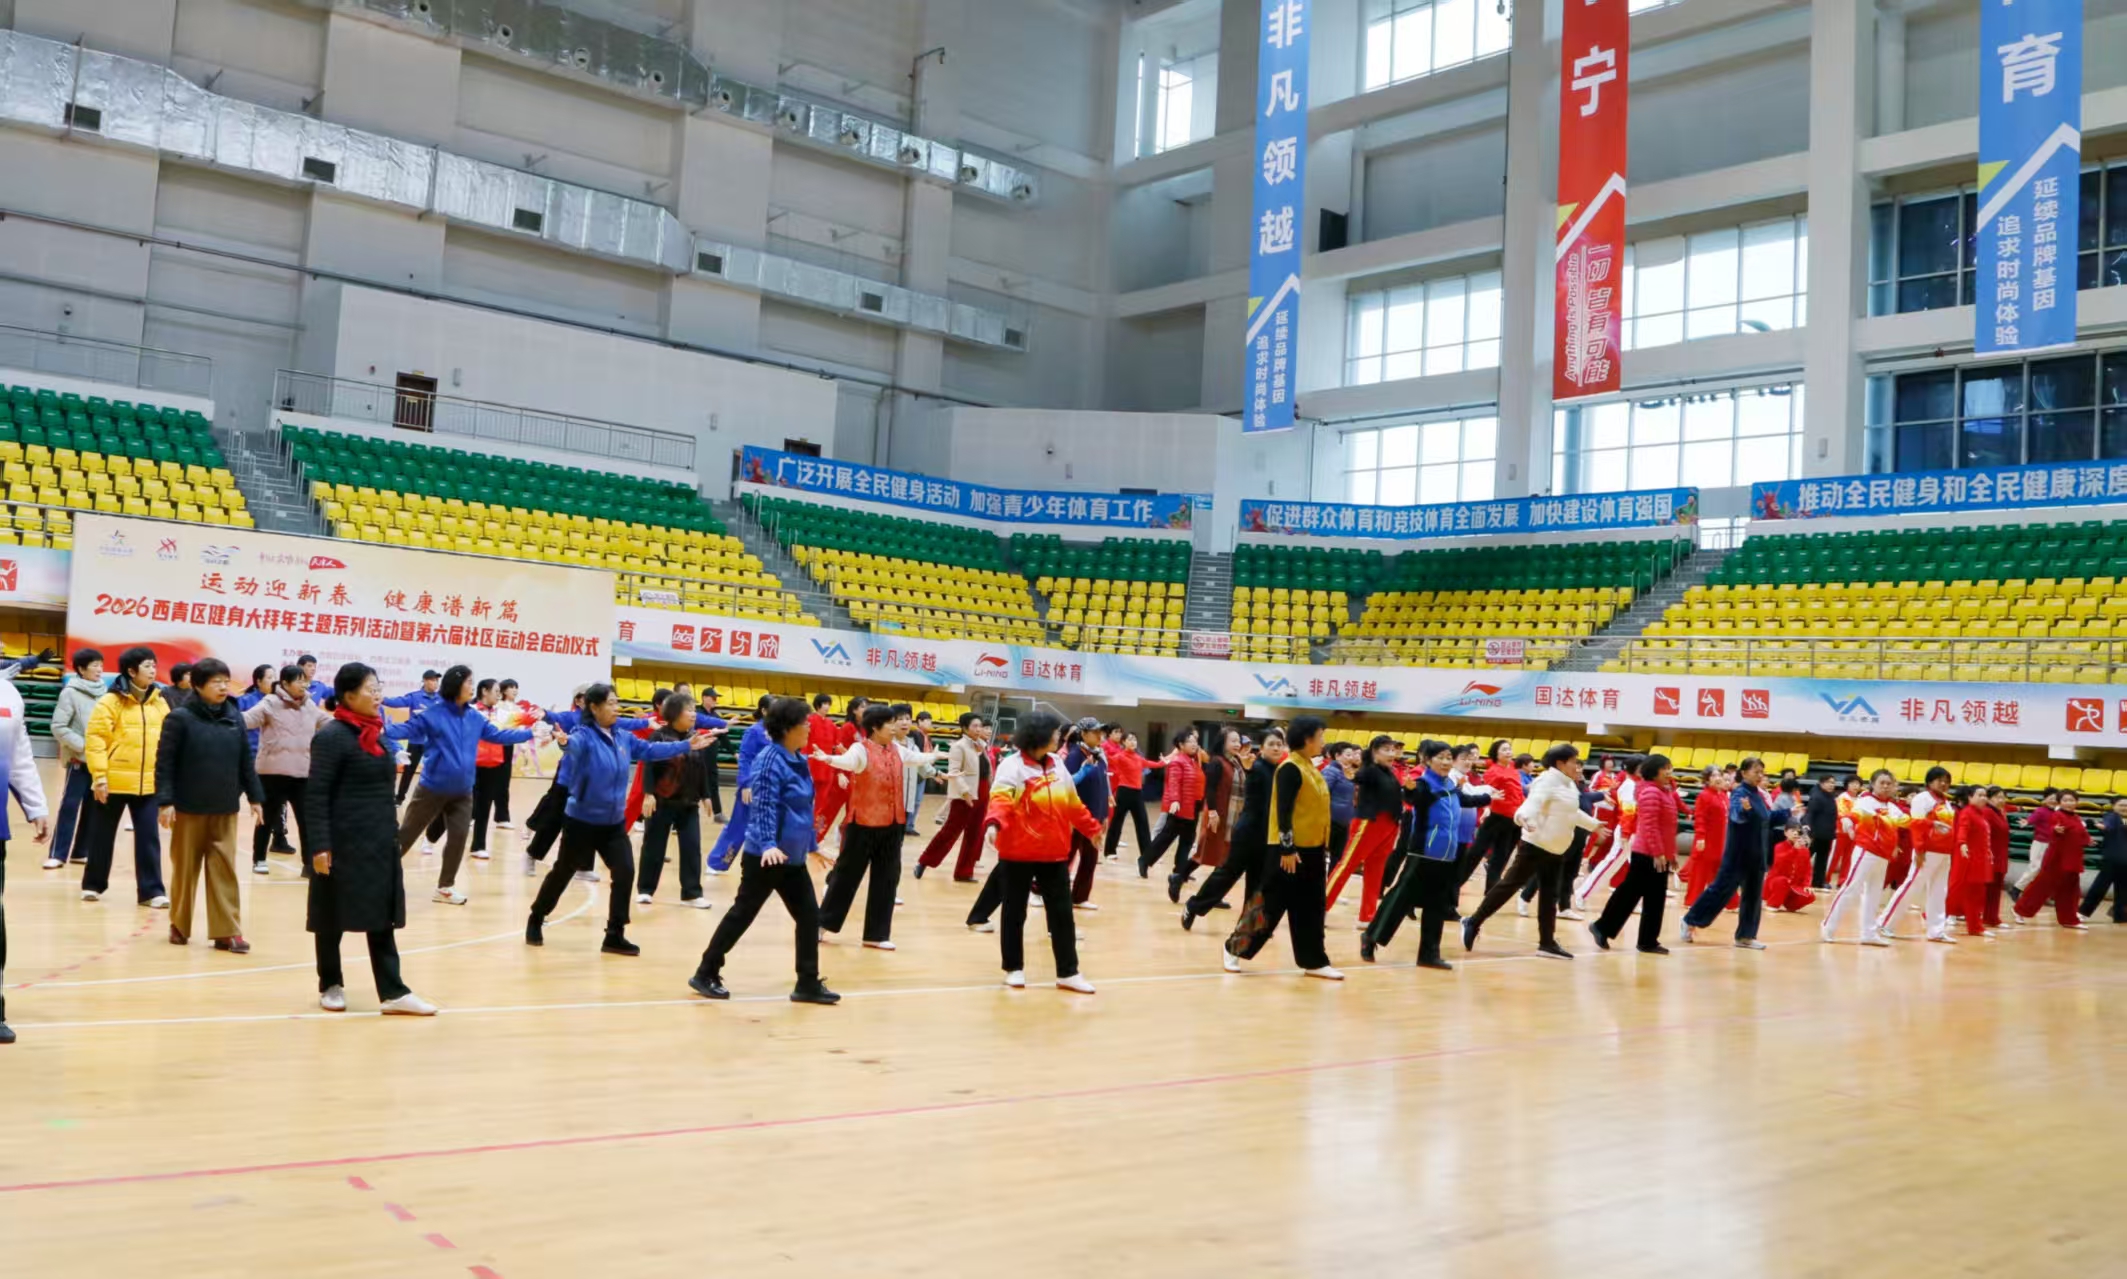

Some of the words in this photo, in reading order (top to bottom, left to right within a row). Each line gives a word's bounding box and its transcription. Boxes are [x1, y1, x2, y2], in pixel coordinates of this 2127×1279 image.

[1571, 0, 1617, 117] 宁
[1996, 0, 2064, 104] 育
[1258, 0, 1303, 256] 非凡领越
[2032, 176, 2059, 312] 延续品牌基因
[1994, 215, 2021, 347] 追求时尚体验
[1585, 244, 1611, 384] 一切皆有可能
[1565, 323, 1578, 382] Anything
[776, 455, 961, 509] 广泛开展全民健身活动
[970, 487, 1154, 523] 加强青少年体育工作
[1265, 503, 1519, 535] 促进群众体育和竞技体育全面发展
[1528, 493, 1673, 527] 加快建设体育强国
[1798, 464, 2127, 512] 推动全民健身和全民健康深度
[93, 593, 600, 657] 2026西青区健身大拜年主题系列活动暨第六届社区运动会启动仪式
[200, 572, 353, 606] 运动迎新春
[383, 589, 522, 624] 健康谱新篇
[618, 620, 637, 642] 育
[866, 647, 937, 673] 非凡领越
[1021, 658, 1083, 682] 国达体育
[1309, 678, 1378, 699] 非凡领越
[1535, 686, 1622, 712] 国达体育
[1899, 697, 2020, 725] 非凡领越
